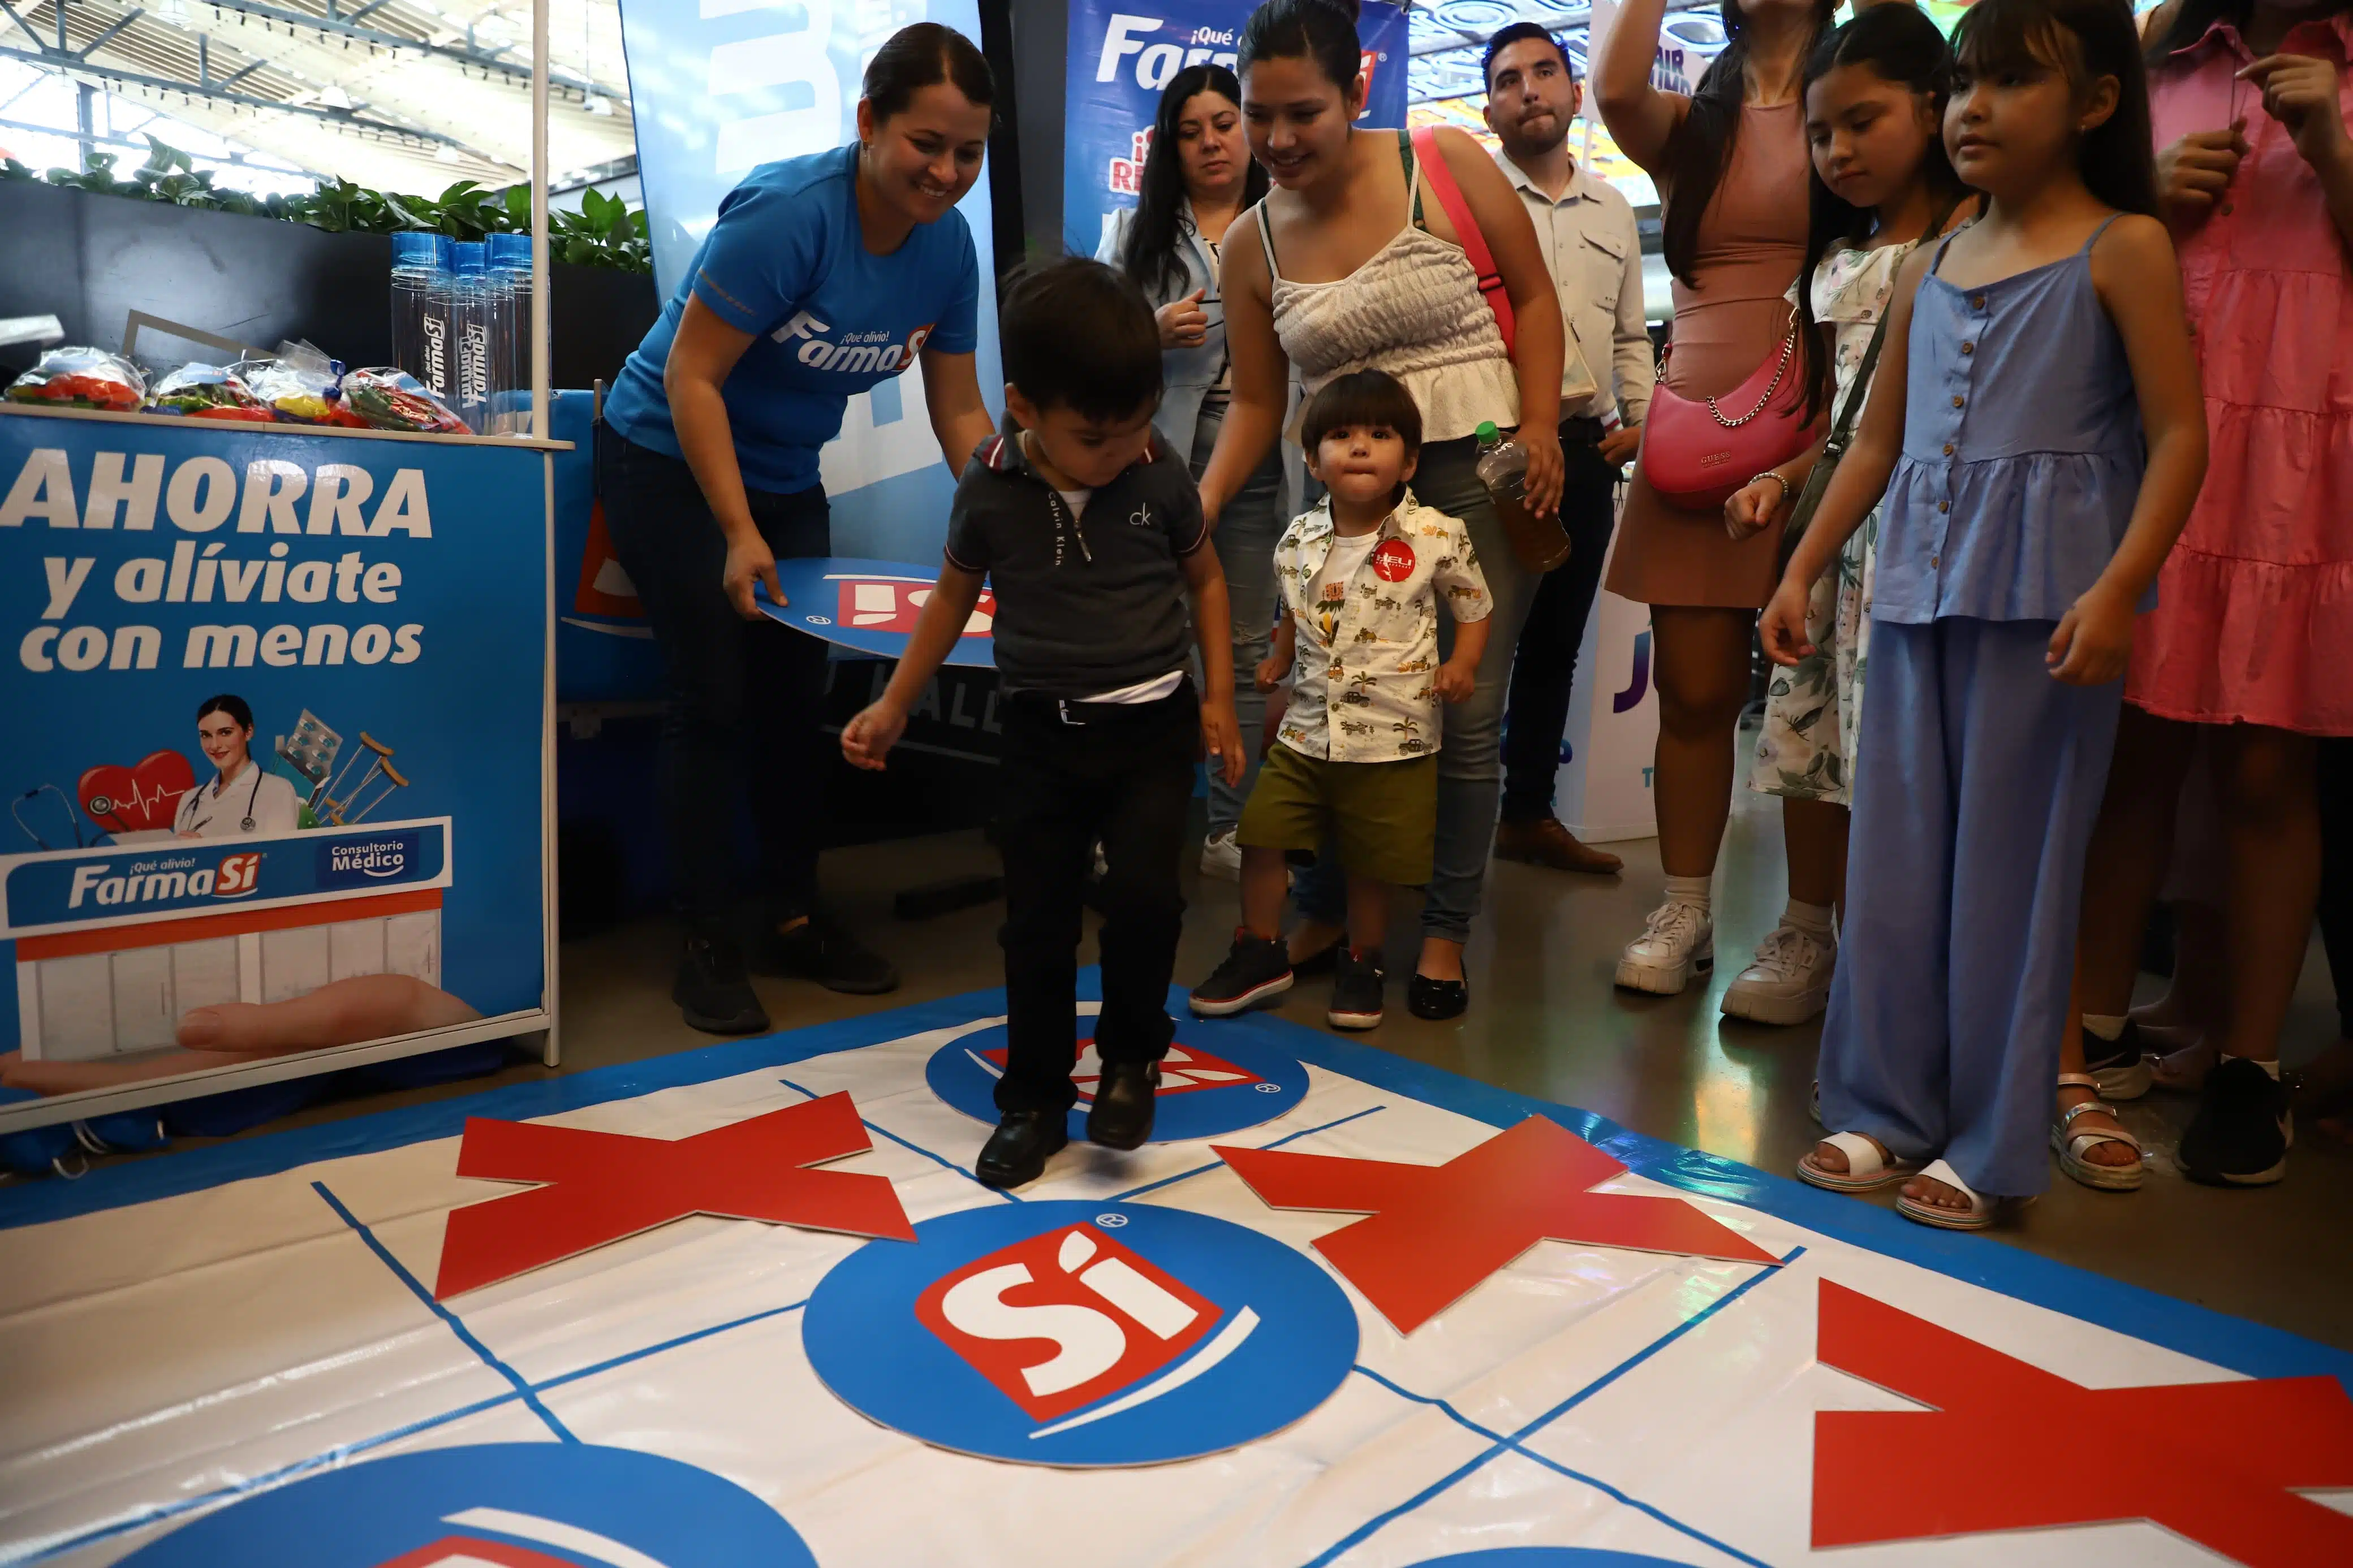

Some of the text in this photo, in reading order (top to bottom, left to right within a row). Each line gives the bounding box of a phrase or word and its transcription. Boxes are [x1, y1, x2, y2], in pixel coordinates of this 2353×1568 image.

[1191, 26, 1234, 45] ¡Qué
[840, 331, 890, 344] ¡Qué alivio!
[425, 316, 445, 399] FarmaSí
[1701, 451, 1730, 464] GUESS
[0, 449, 432, 538] AHORRA
[1048, 491, 1066, 565] Calvin Klein
[1130, 502, 1151, 525] ck
[41, 541, 402, 619] y alíviate
[19, 624, 424, 671] con menos
[130, 857, 196, 875] ¡Qué alivio!
[332, 841, 403, 856] Consultorio
[332, 852, 404, 871] Médico
[68, 856, 260, 909] FarmaSí
[942, 1230, 1199, 1397] Sí
